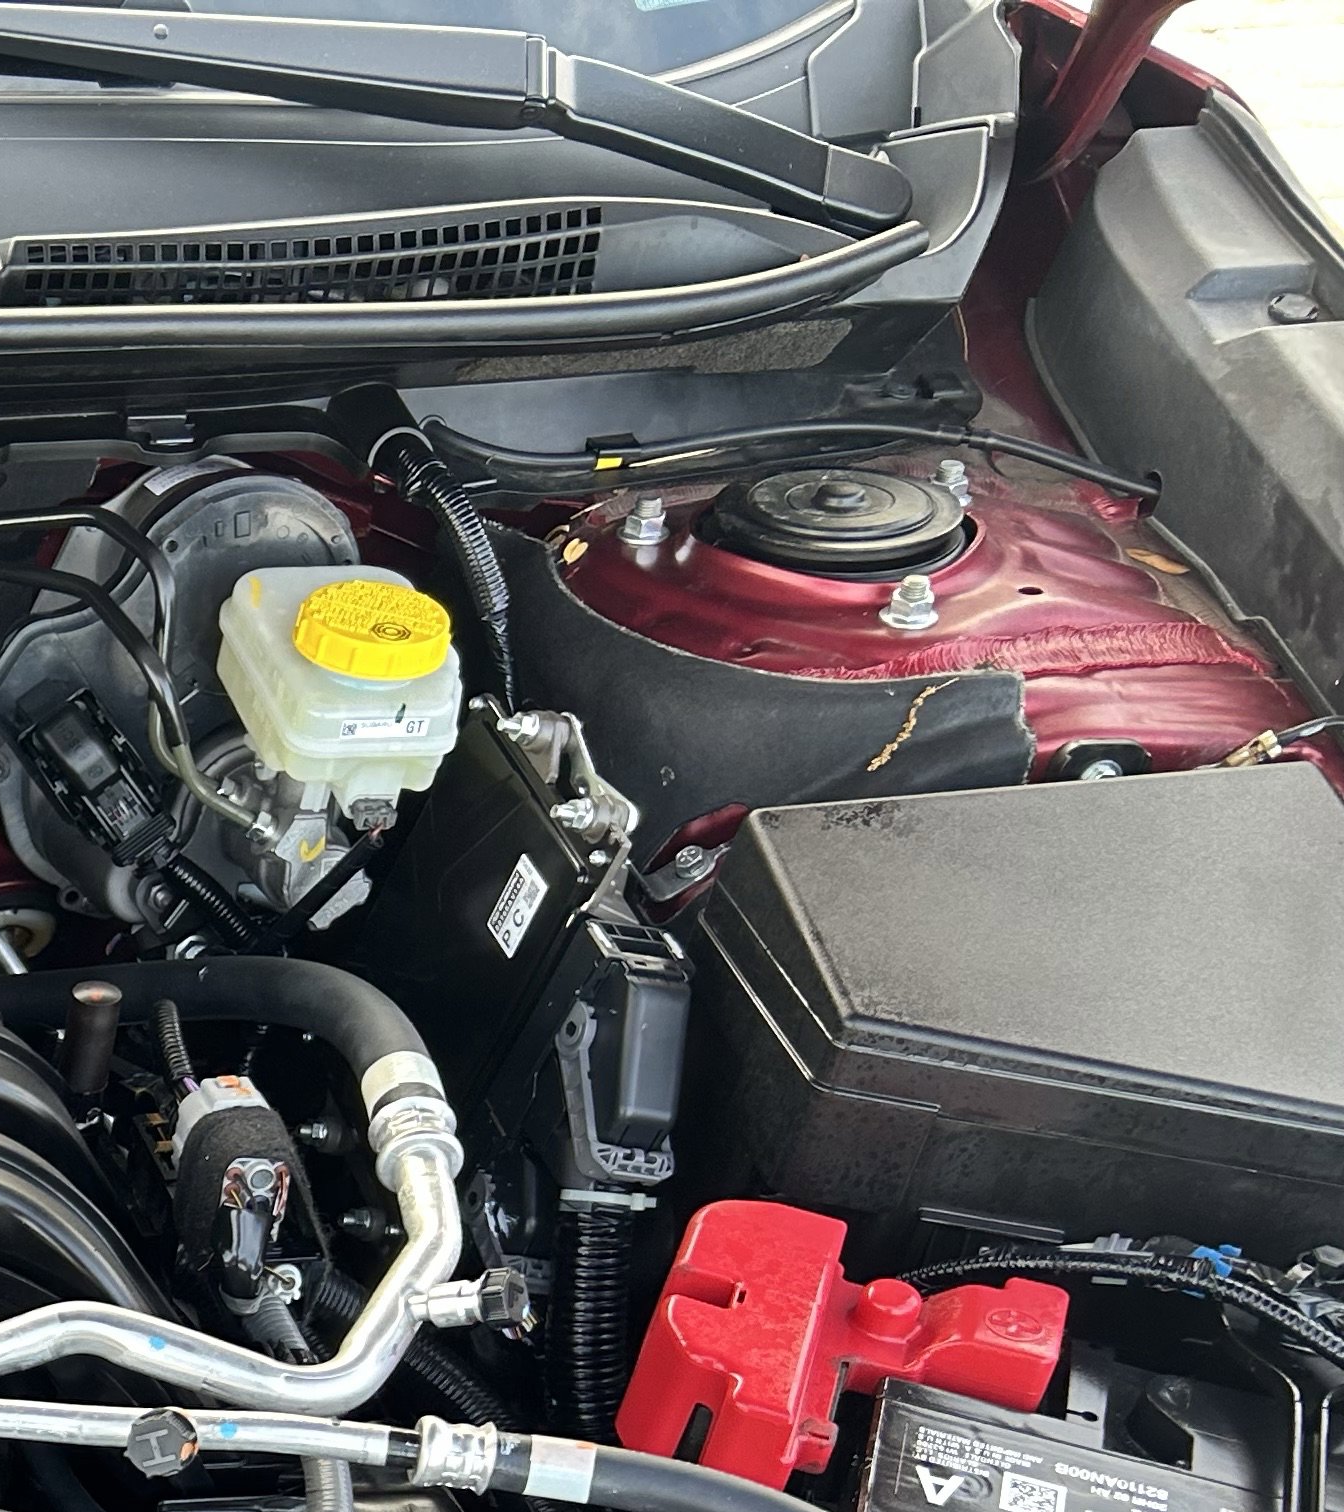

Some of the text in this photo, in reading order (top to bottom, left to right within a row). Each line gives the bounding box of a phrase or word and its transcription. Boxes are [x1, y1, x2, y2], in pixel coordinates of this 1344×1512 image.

[406, 720, 425, 734] GT
[502, 908, 525, 949] P C
